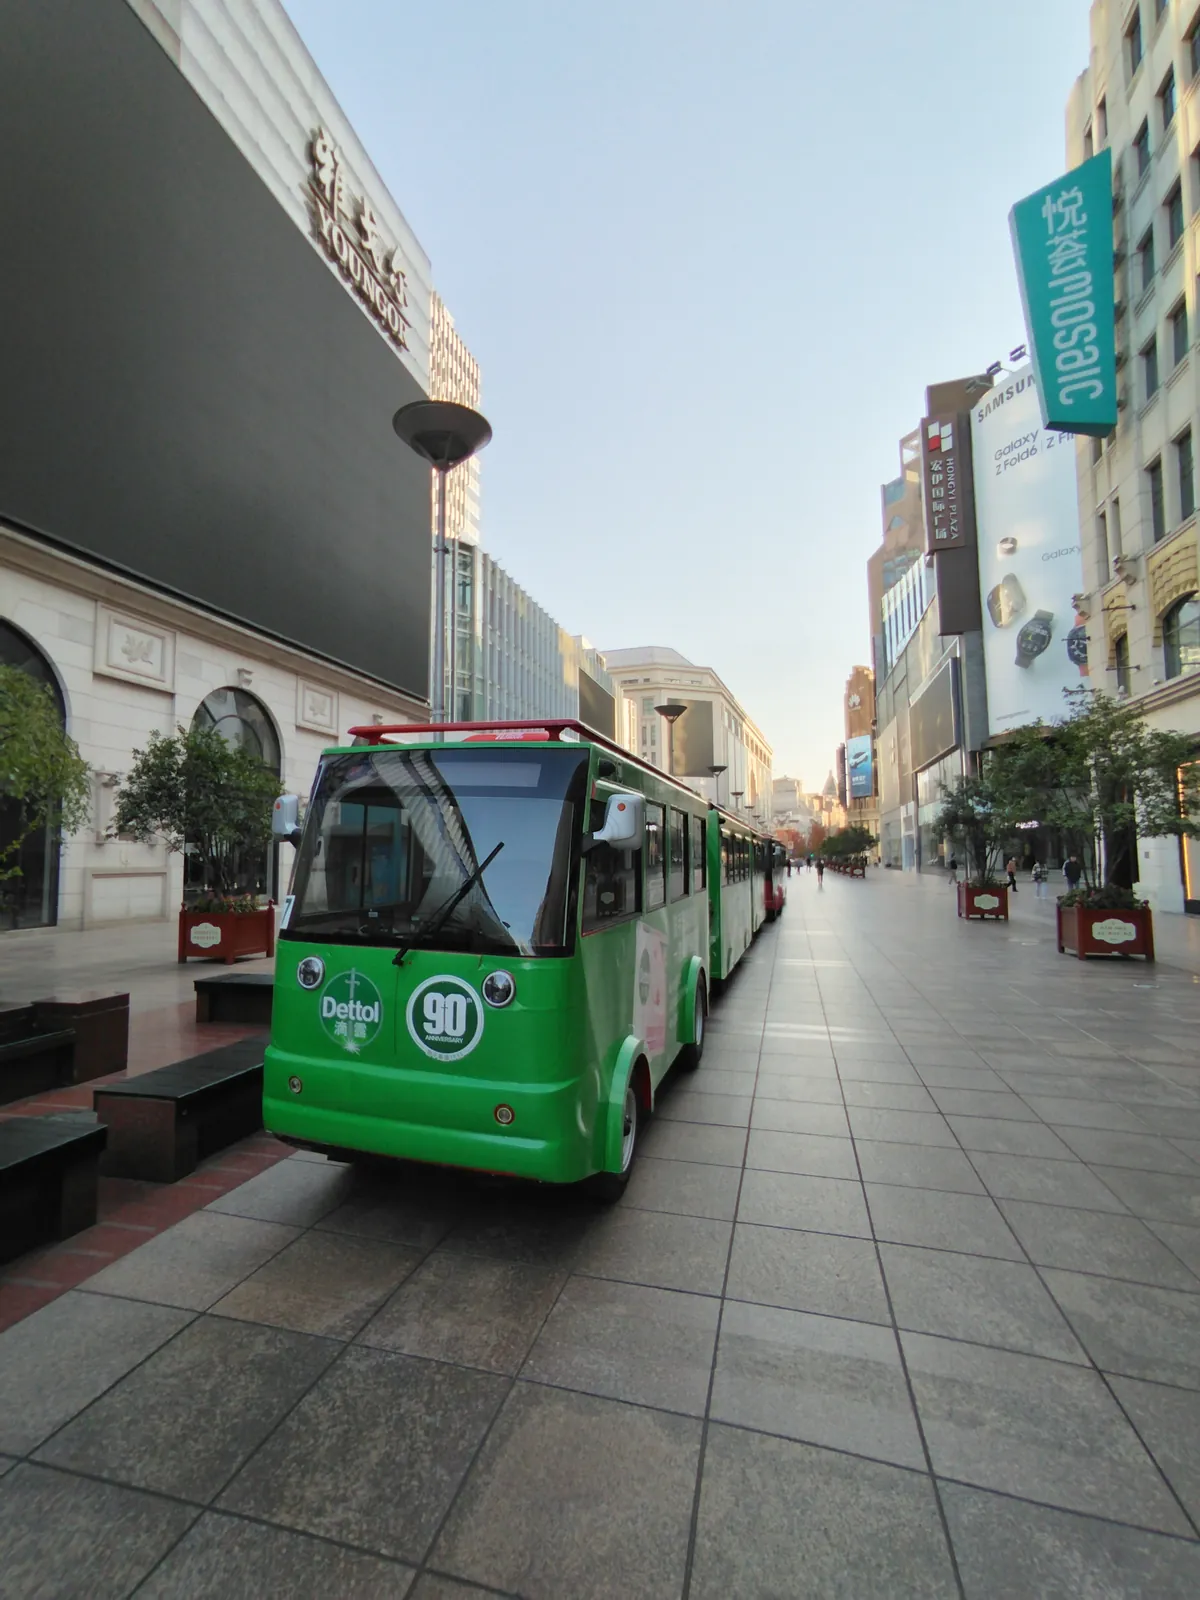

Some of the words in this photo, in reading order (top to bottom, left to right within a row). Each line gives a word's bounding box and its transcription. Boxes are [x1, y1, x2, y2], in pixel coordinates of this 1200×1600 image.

[316, 200, 410, 352] YOUNGOR
[994, 429, 1039, 461] Galaxy
[996, 464, 1002, 476] Z
[1003, 445, 1037, 470] Fold6
[1046, 436, 1055, 449] Z
[946, 458, 957, 500] HONGYI
[949, 504, 959, 540] PLAZA
[322, 996, 379, 1023] Dettol
[425, 1035, 463, 1044] ANNIVERSARY
